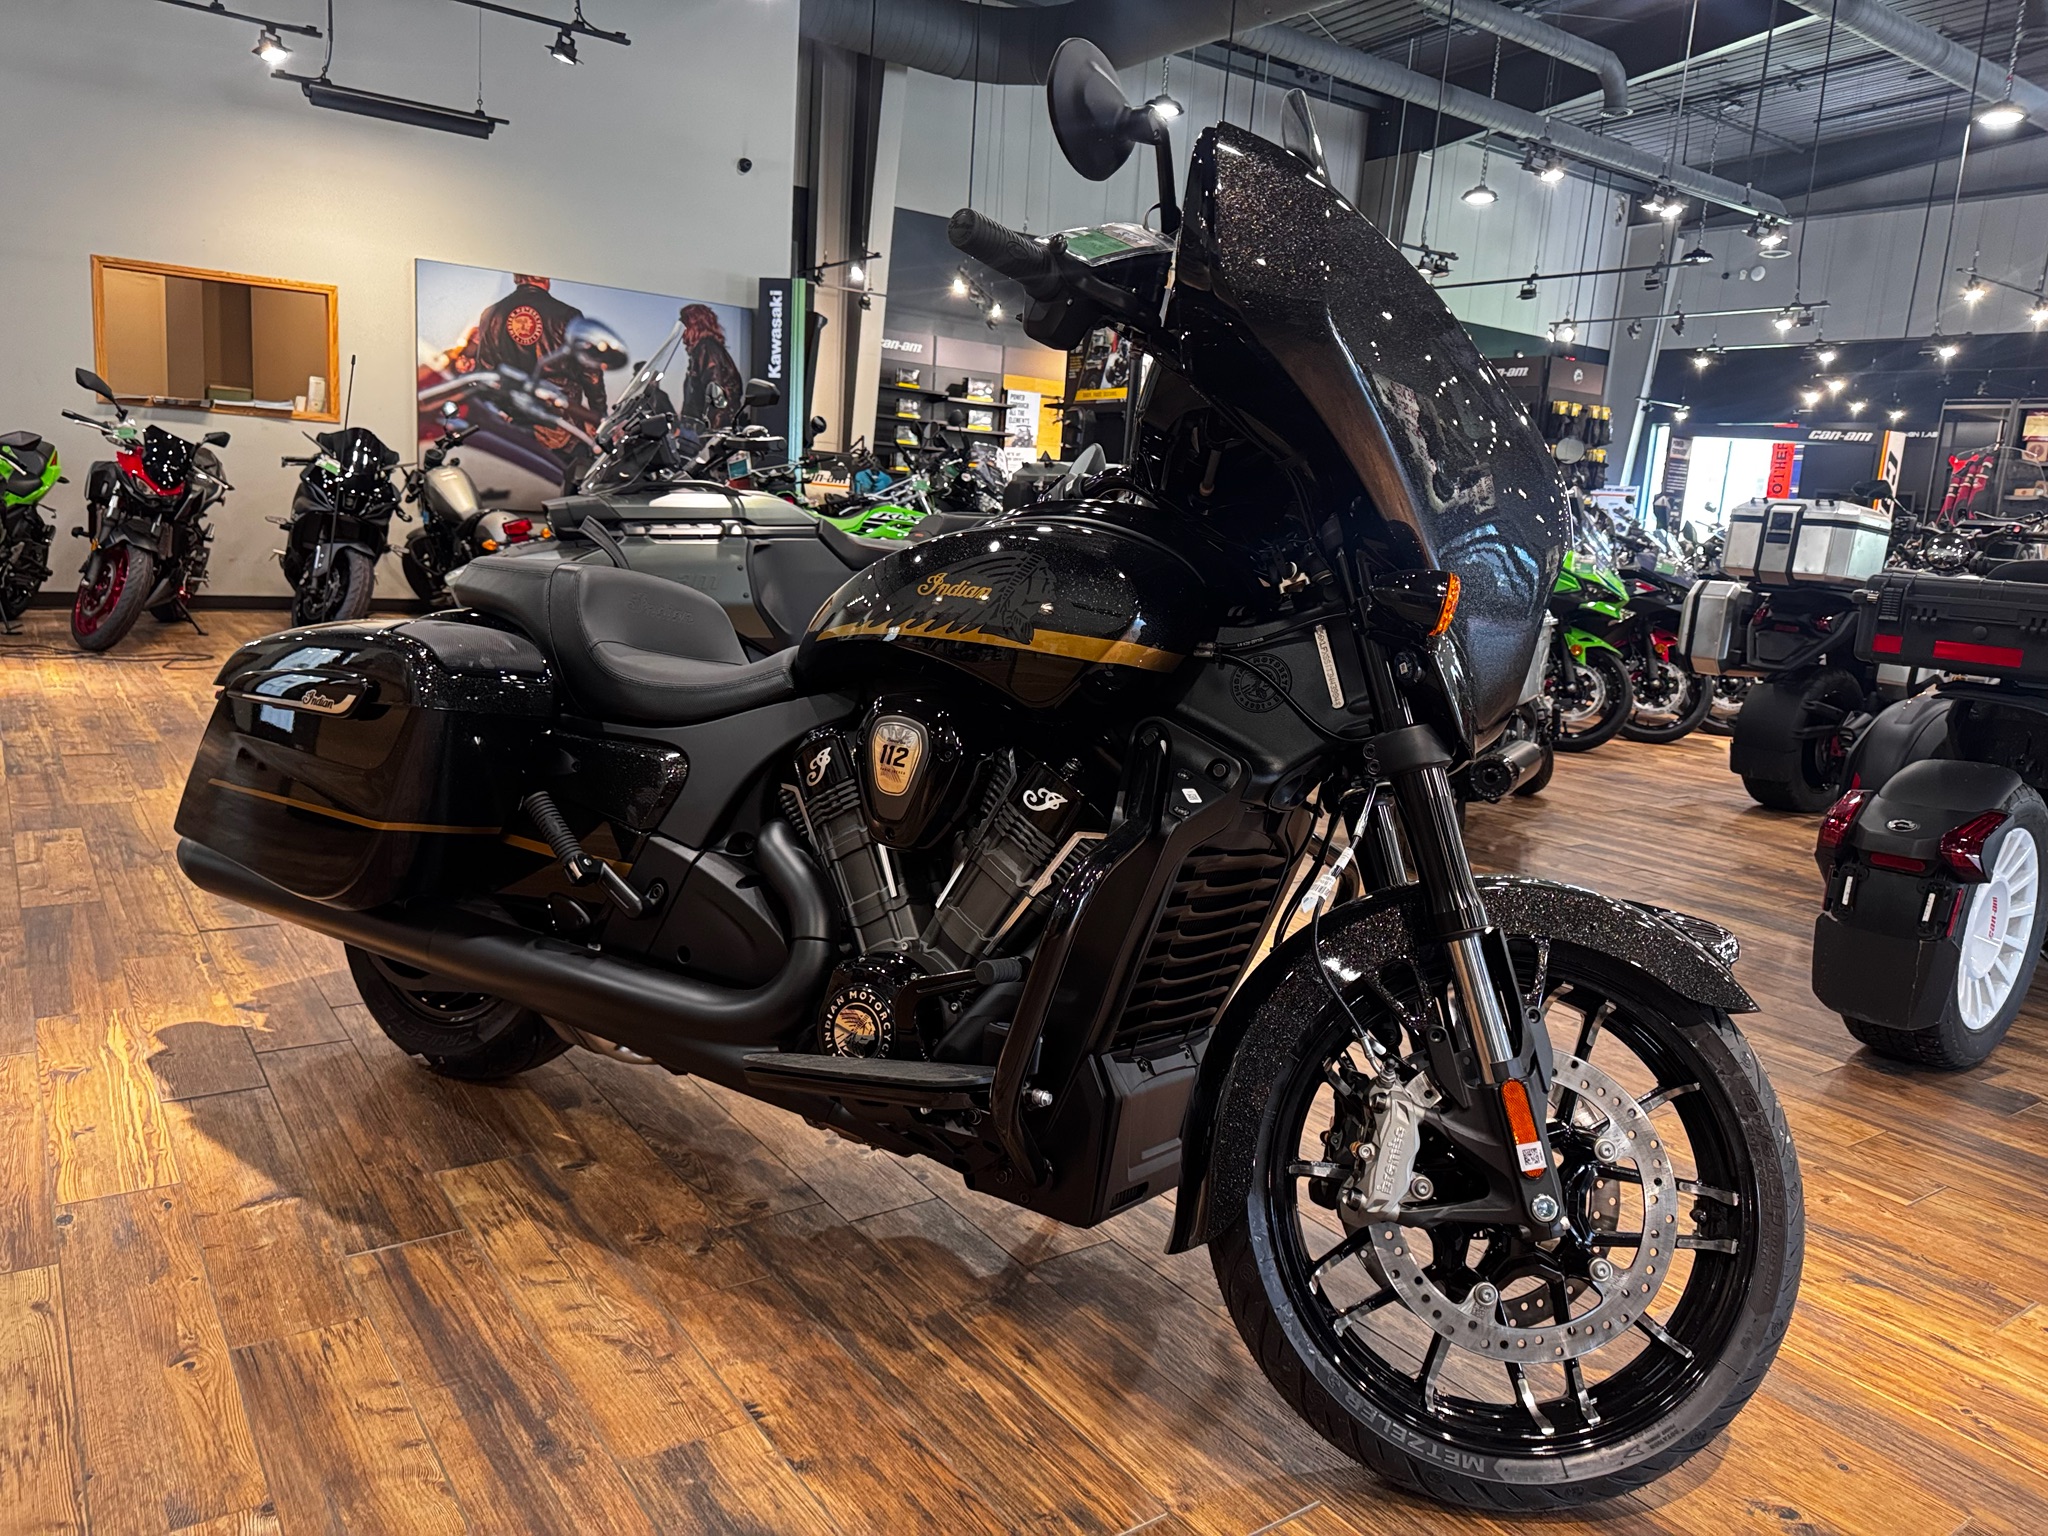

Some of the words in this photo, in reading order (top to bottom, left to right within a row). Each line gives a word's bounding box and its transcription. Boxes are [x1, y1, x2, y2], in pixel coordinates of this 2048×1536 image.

[768, 290, 783, 379] Kawasaki
[1808, 430, 1873, 442] can-am
[917, 572, 993, 600] Indian
[302, 690, 334, 709] Indian
[880, 744, 909, 768] 112
[1988, 896, 1998, 938] can-am
[824, 996, 845, 1049] INDIAN
[1376, 1126, 1405, 1194] brembo
[1345, 1391, 1485, 1474] METZELER
